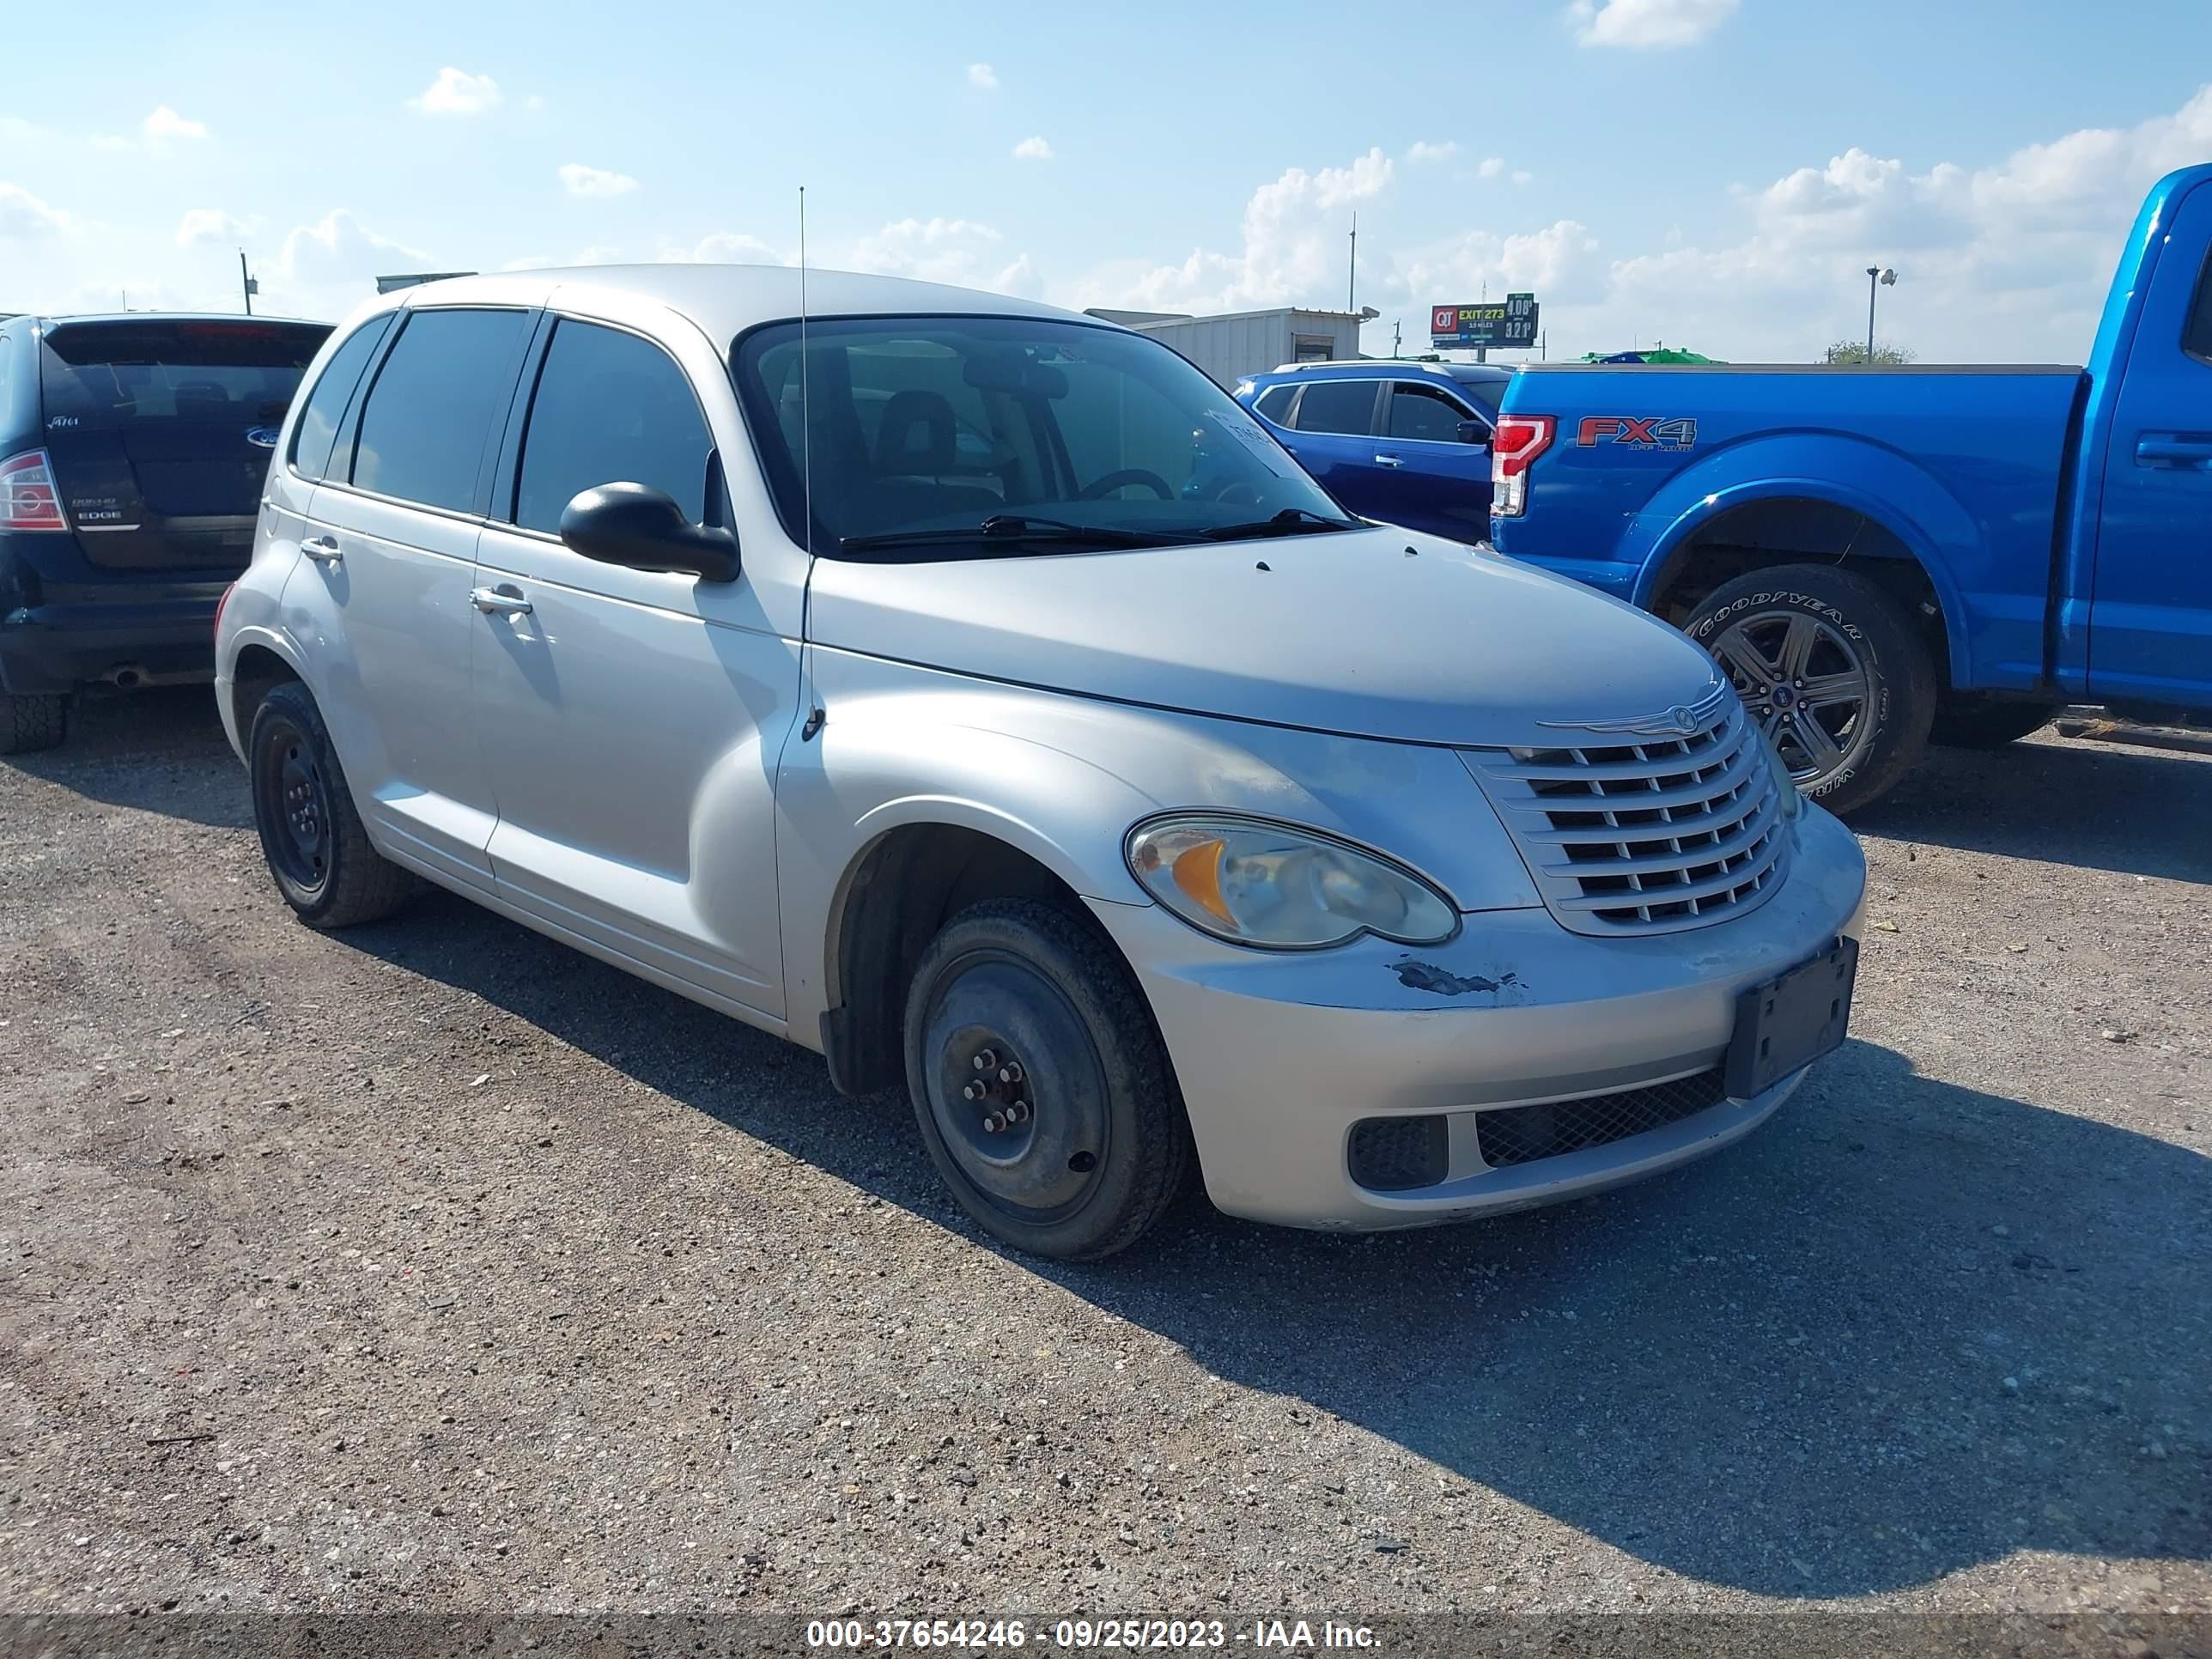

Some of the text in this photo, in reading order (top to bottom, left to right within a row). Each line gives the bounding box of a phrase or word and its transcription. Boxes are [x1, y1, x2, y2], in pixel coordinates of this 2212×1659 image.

[1436, 311, 1453, 328] QT
[1459, 310, 1482, 320] EXIT
[1484, 309, 1504, 319] 273
[1577, 416, 1698, 447] FX4
[78, 511, 122, 520] EDGE
